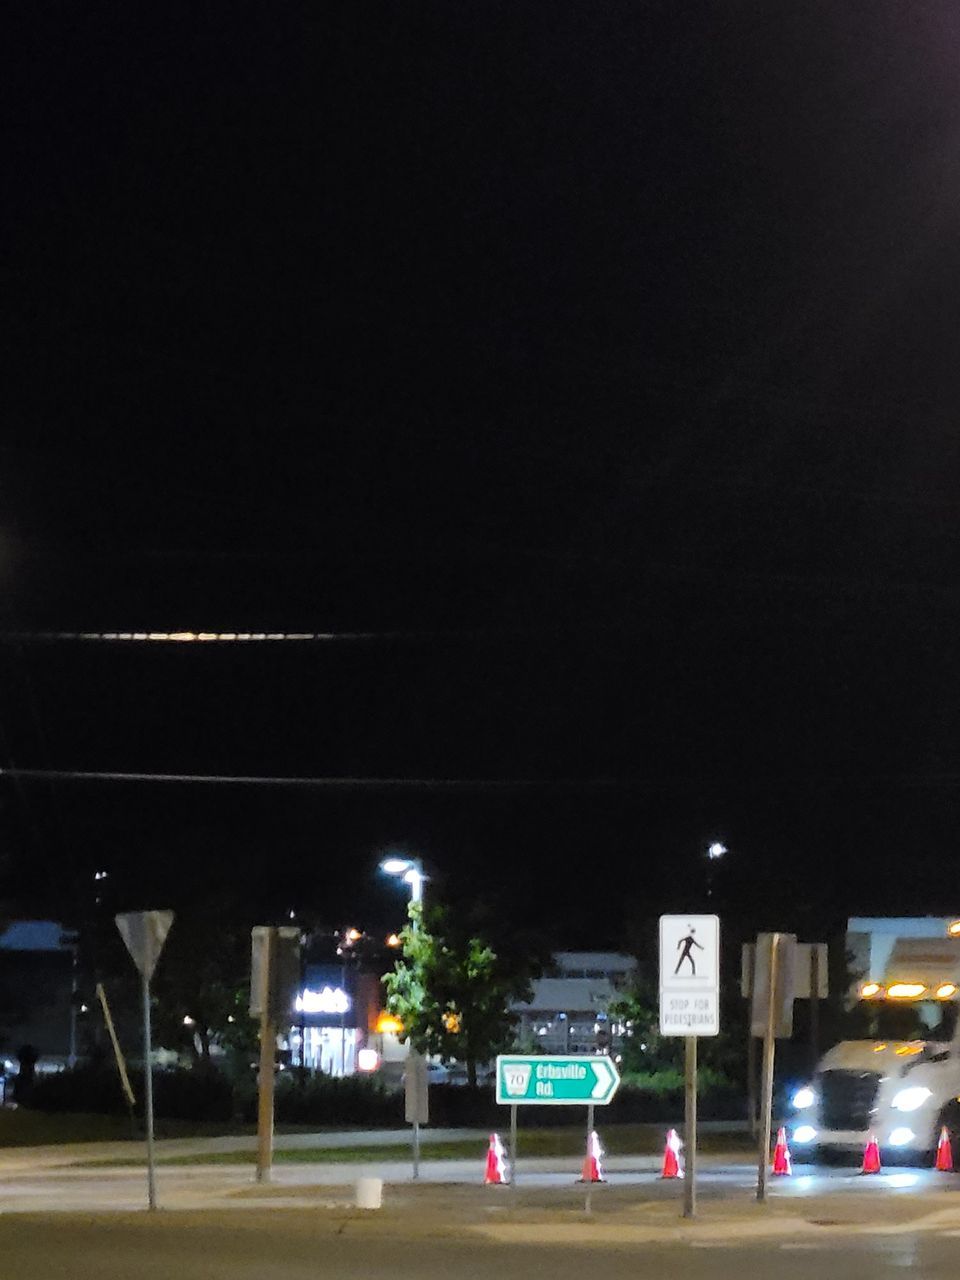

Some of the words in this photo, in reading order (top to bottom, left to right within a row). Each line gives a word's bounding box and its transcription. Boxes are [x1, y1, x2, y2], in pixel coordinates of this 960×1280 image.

[670, 999, 689, 1010] STOP
[694, 999, 710, 1010] FOR
[664, 1014, 715, 1025] PEDESTRIANS
[510, 1074, 525, 1086] 70
